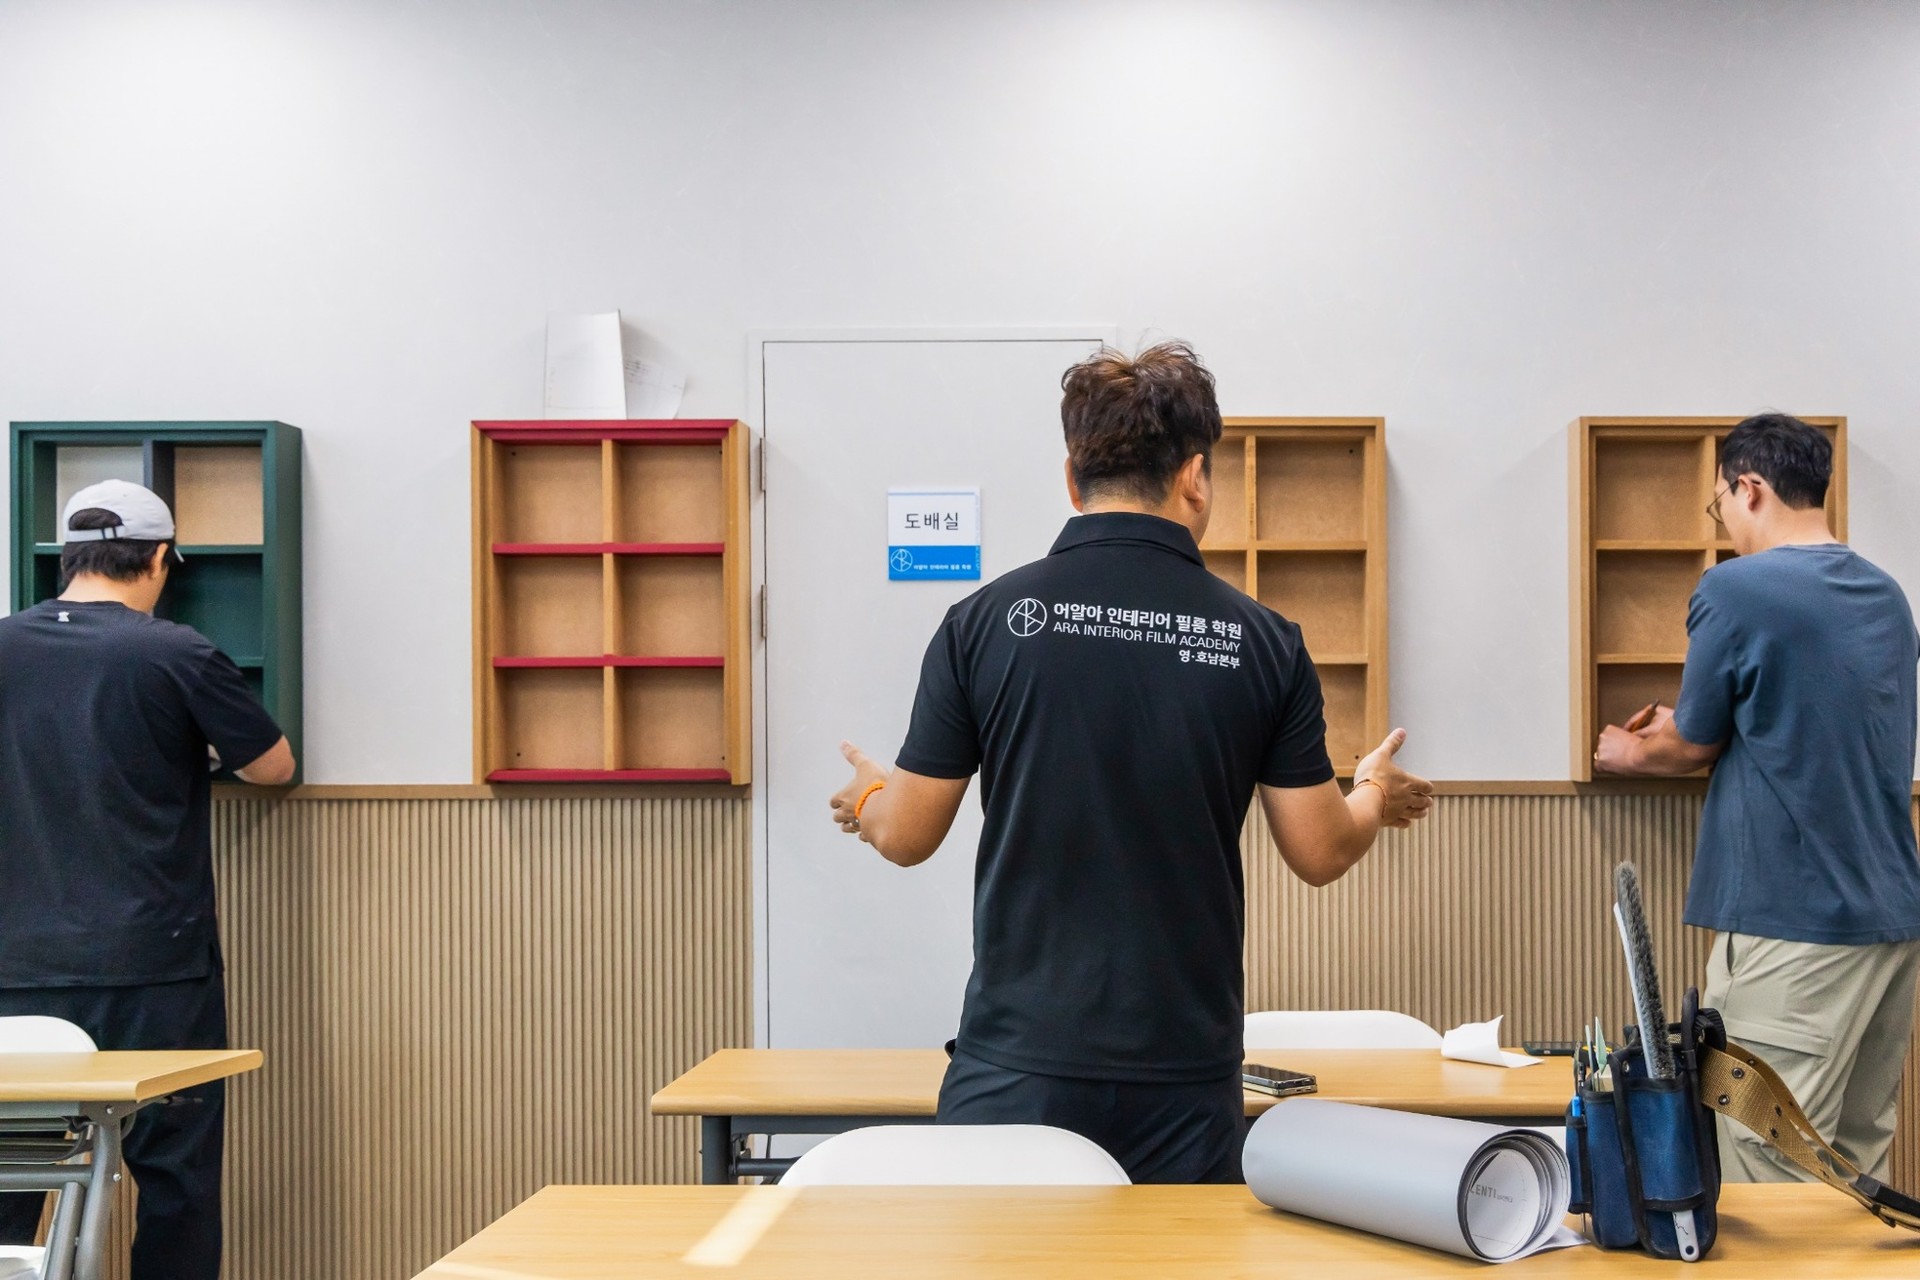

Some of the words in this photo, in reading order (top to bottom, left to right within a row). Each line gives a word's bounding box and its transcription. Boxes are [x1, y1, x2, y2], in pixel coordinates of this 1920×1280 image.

[904, 512, 959, 531] 도배실
[1053, 603, 1103, 623] 어알아
[1106, 607, 1171, 630] 인테리어
[1175, 614, 1208, 634] 필름
[1211, 619, 1242, 640] 학원
[1053, 621, 1081, 635] ARA
[1083, 624, 1143, 642] INTERIOR
[1146, 631, 1177, 645] FILM
[1179, 635, 1241, 653] ACADEMY
